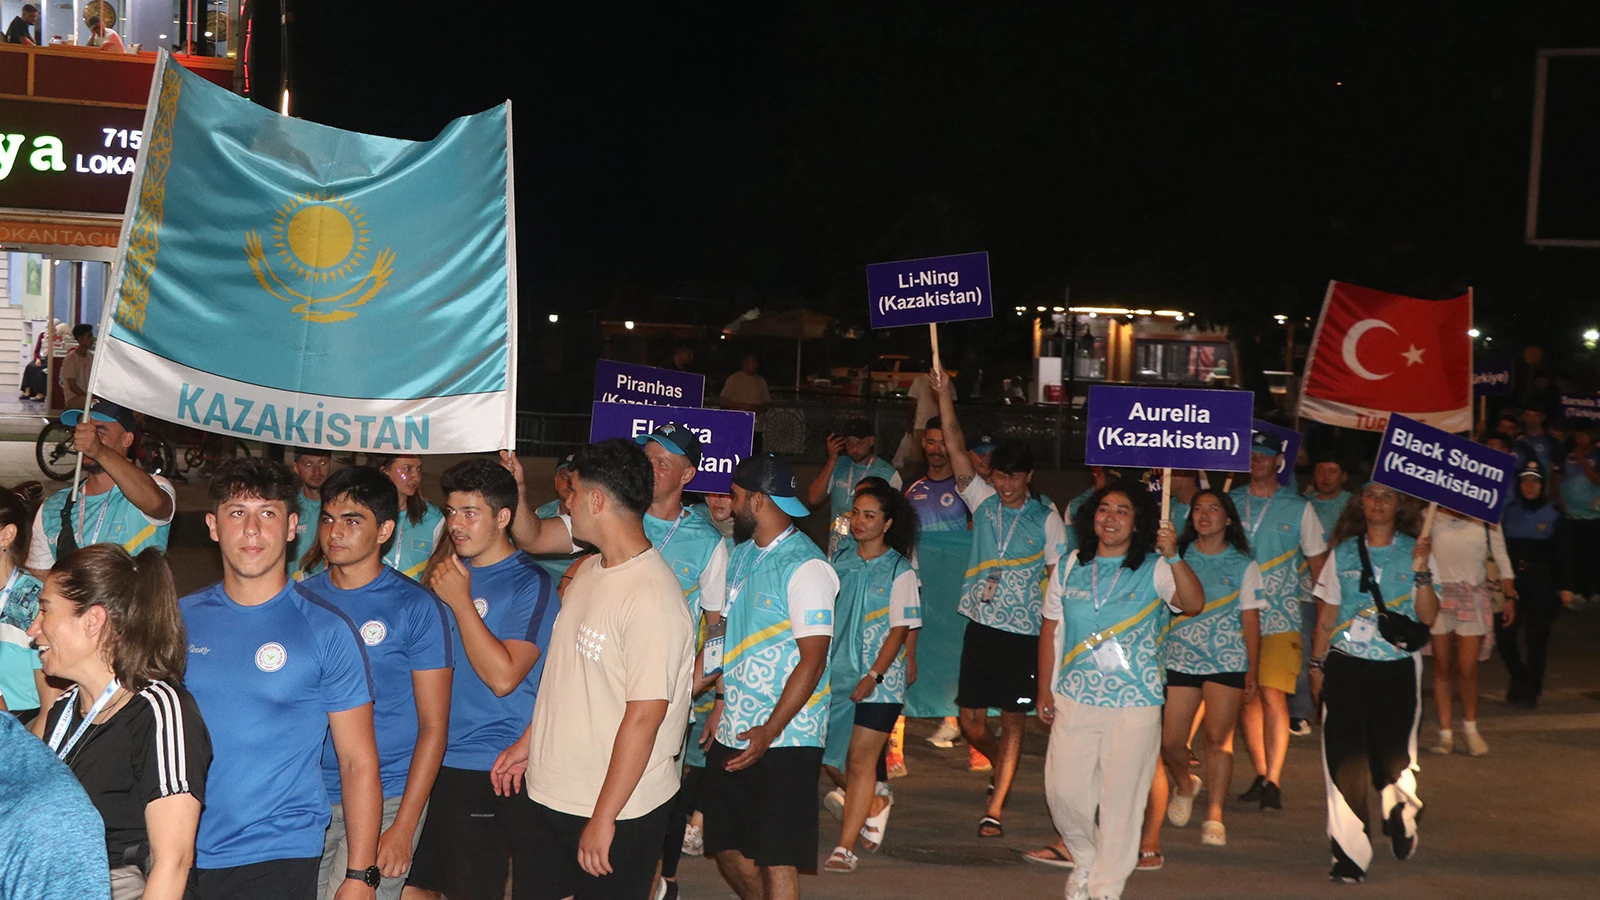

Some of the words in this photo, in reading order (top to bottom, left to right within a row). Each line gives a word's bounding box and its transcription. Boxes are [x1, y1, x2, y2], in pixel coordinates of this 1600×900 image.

[103, 127, 143, 150] 715
[898, 270, 959, 288] Li-Ning
[879, 286, 982, 315] (Kazakistan)
[616, 373, 683, 399] Piranhas
[177, 382, 430, 450] KAZAKİSTAN
[1128, 402, 1211, 424] Aurelia
[1098, 426, 1240, 456] (Kazakistan)
[1391, 427, 1445, 461] Black
[1447, 448, 1504, 483] Storm
[1384, 451, 1498, 510] (Kazakistan)
